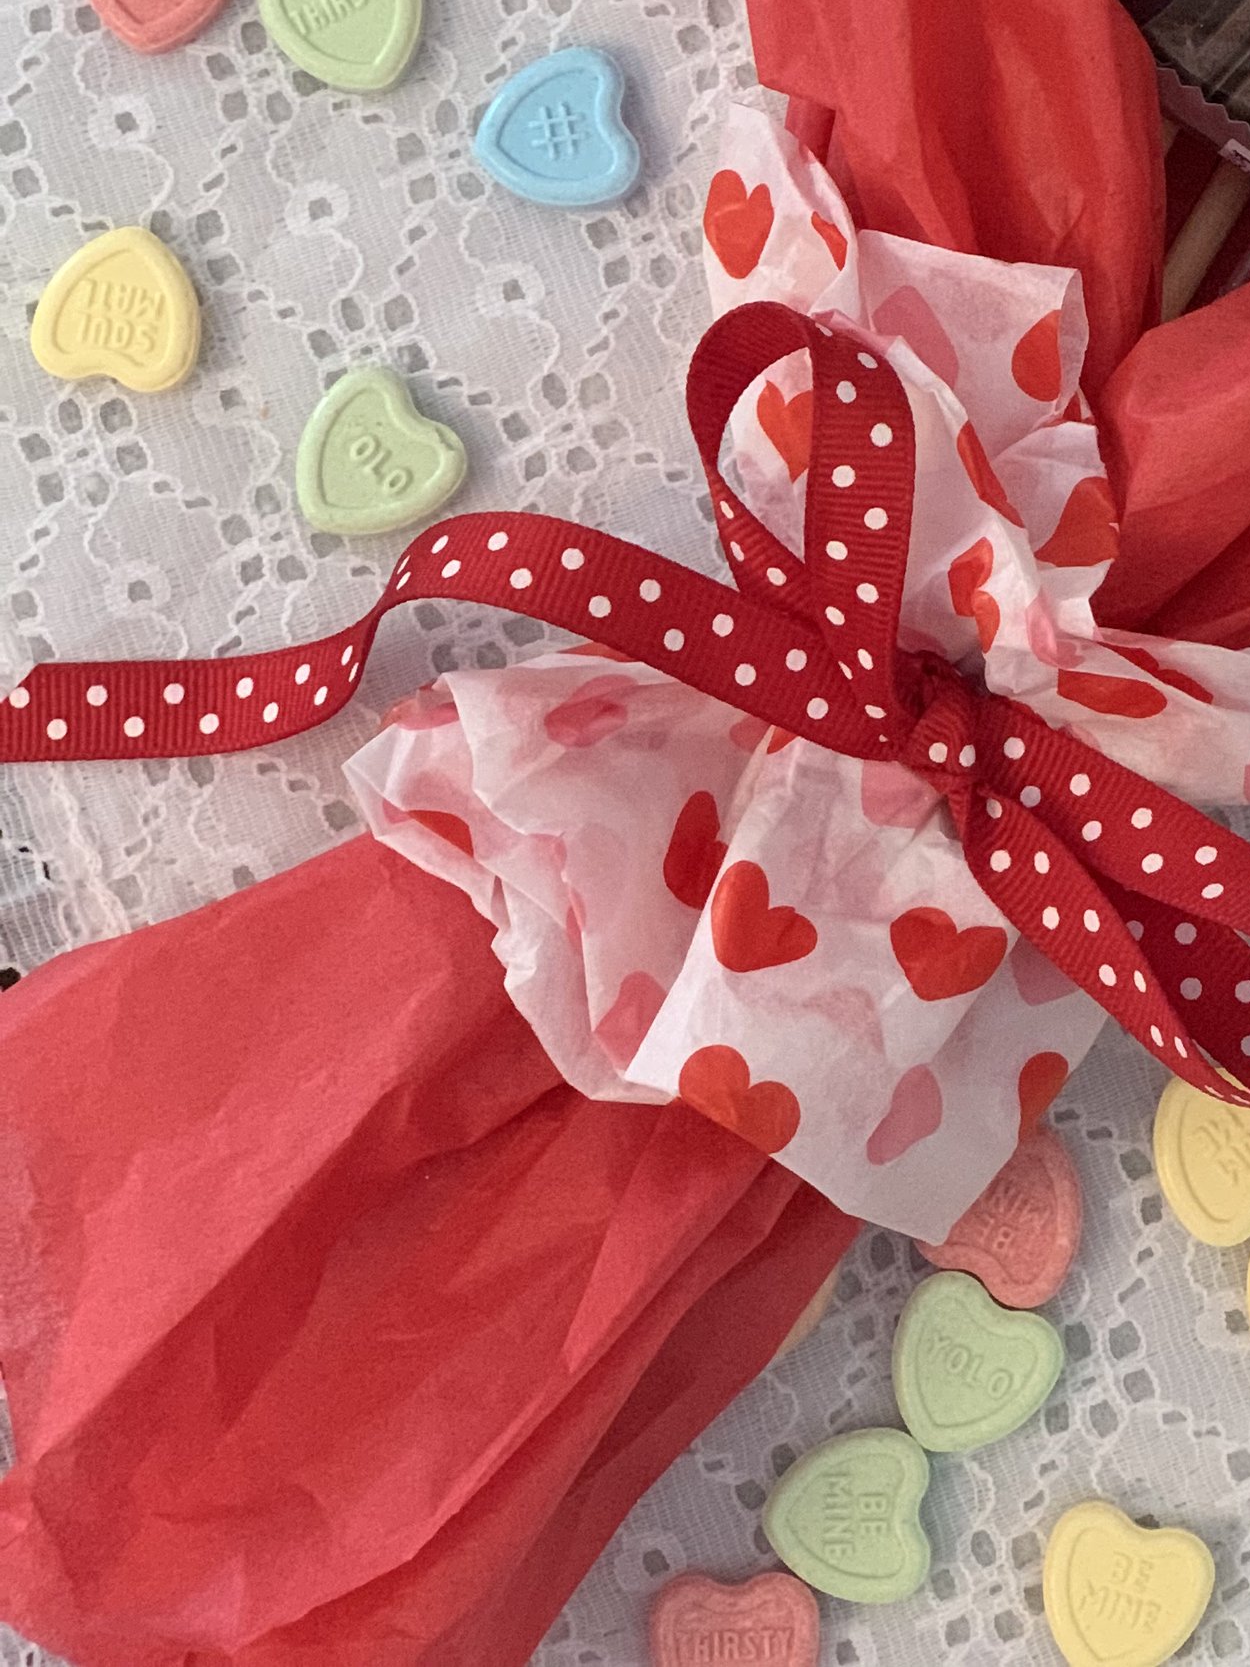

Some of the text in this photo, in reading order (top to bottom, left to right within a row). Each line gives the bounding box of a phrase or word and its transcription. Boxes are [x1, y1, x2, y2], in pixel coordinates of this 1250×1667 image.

[982, 1174, 1049, 1231] MIN
[926, 1329, 1015, 1402] YOLO
[822, 1474, 850, 1561] MINE
[861, 1495, 886, 1536] BE
[1106, 1549, 1153, 1588] BE
[1077, 1580, 1163, 1636] MINE
[677, 1627, 790, 1662] THIRSTY
